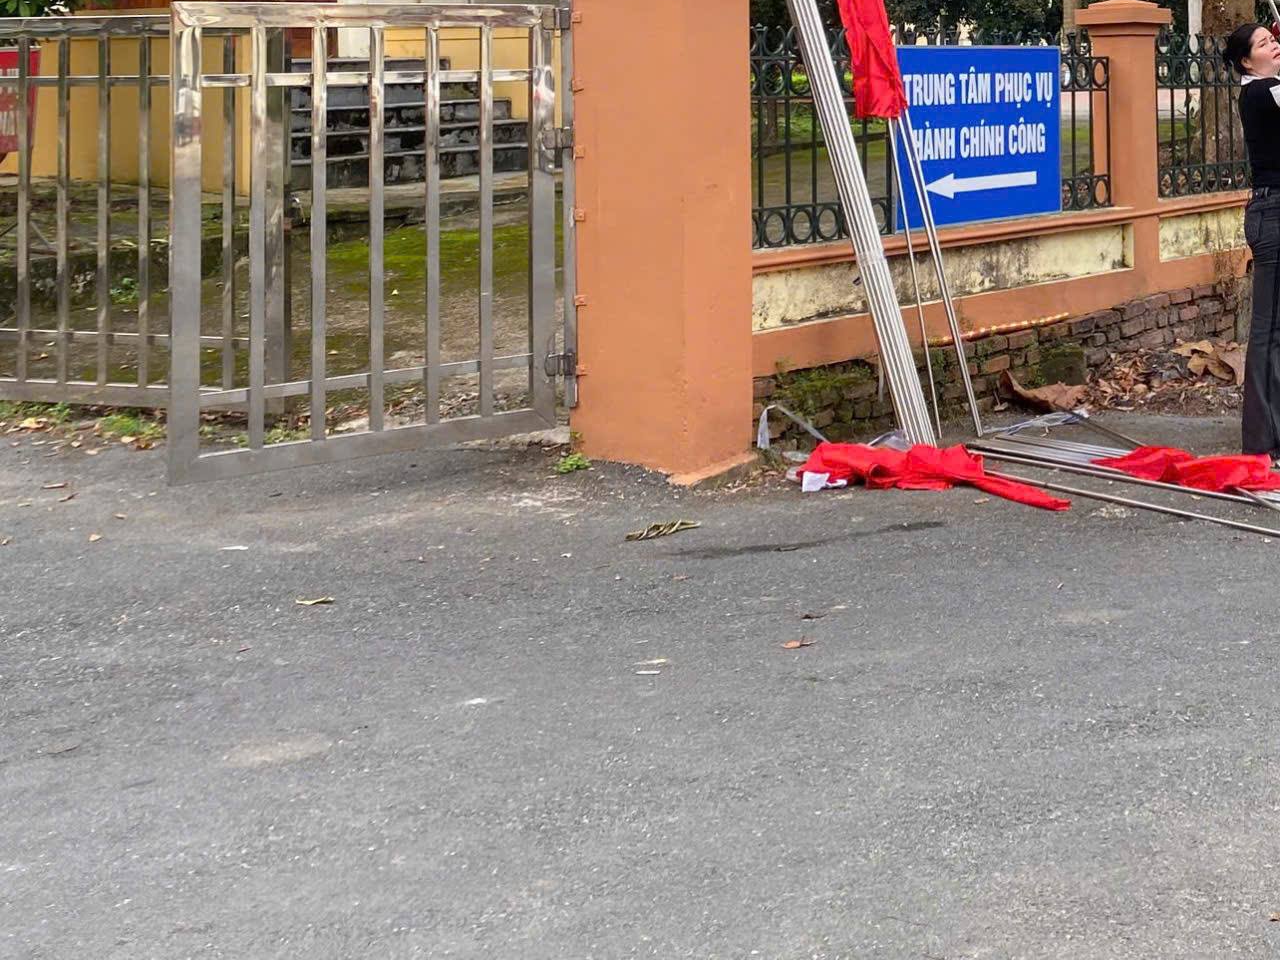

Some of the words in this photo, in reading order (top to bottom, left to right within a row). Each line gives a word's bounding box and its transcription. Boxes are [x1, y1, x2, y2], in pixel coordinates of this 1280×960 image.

[903, 73, 955, 106] TRUNG
[959, 65, 992, 104] TÂM
[995, 72, 1032, 108] PHỤC
[1036, 72, 1053, 108] VỤ
[912, 121, 955, 161] HÀNH
[960, 119, 1005, 159] CHÍNH
[1008, 117, 1046, 155] CÔNG
